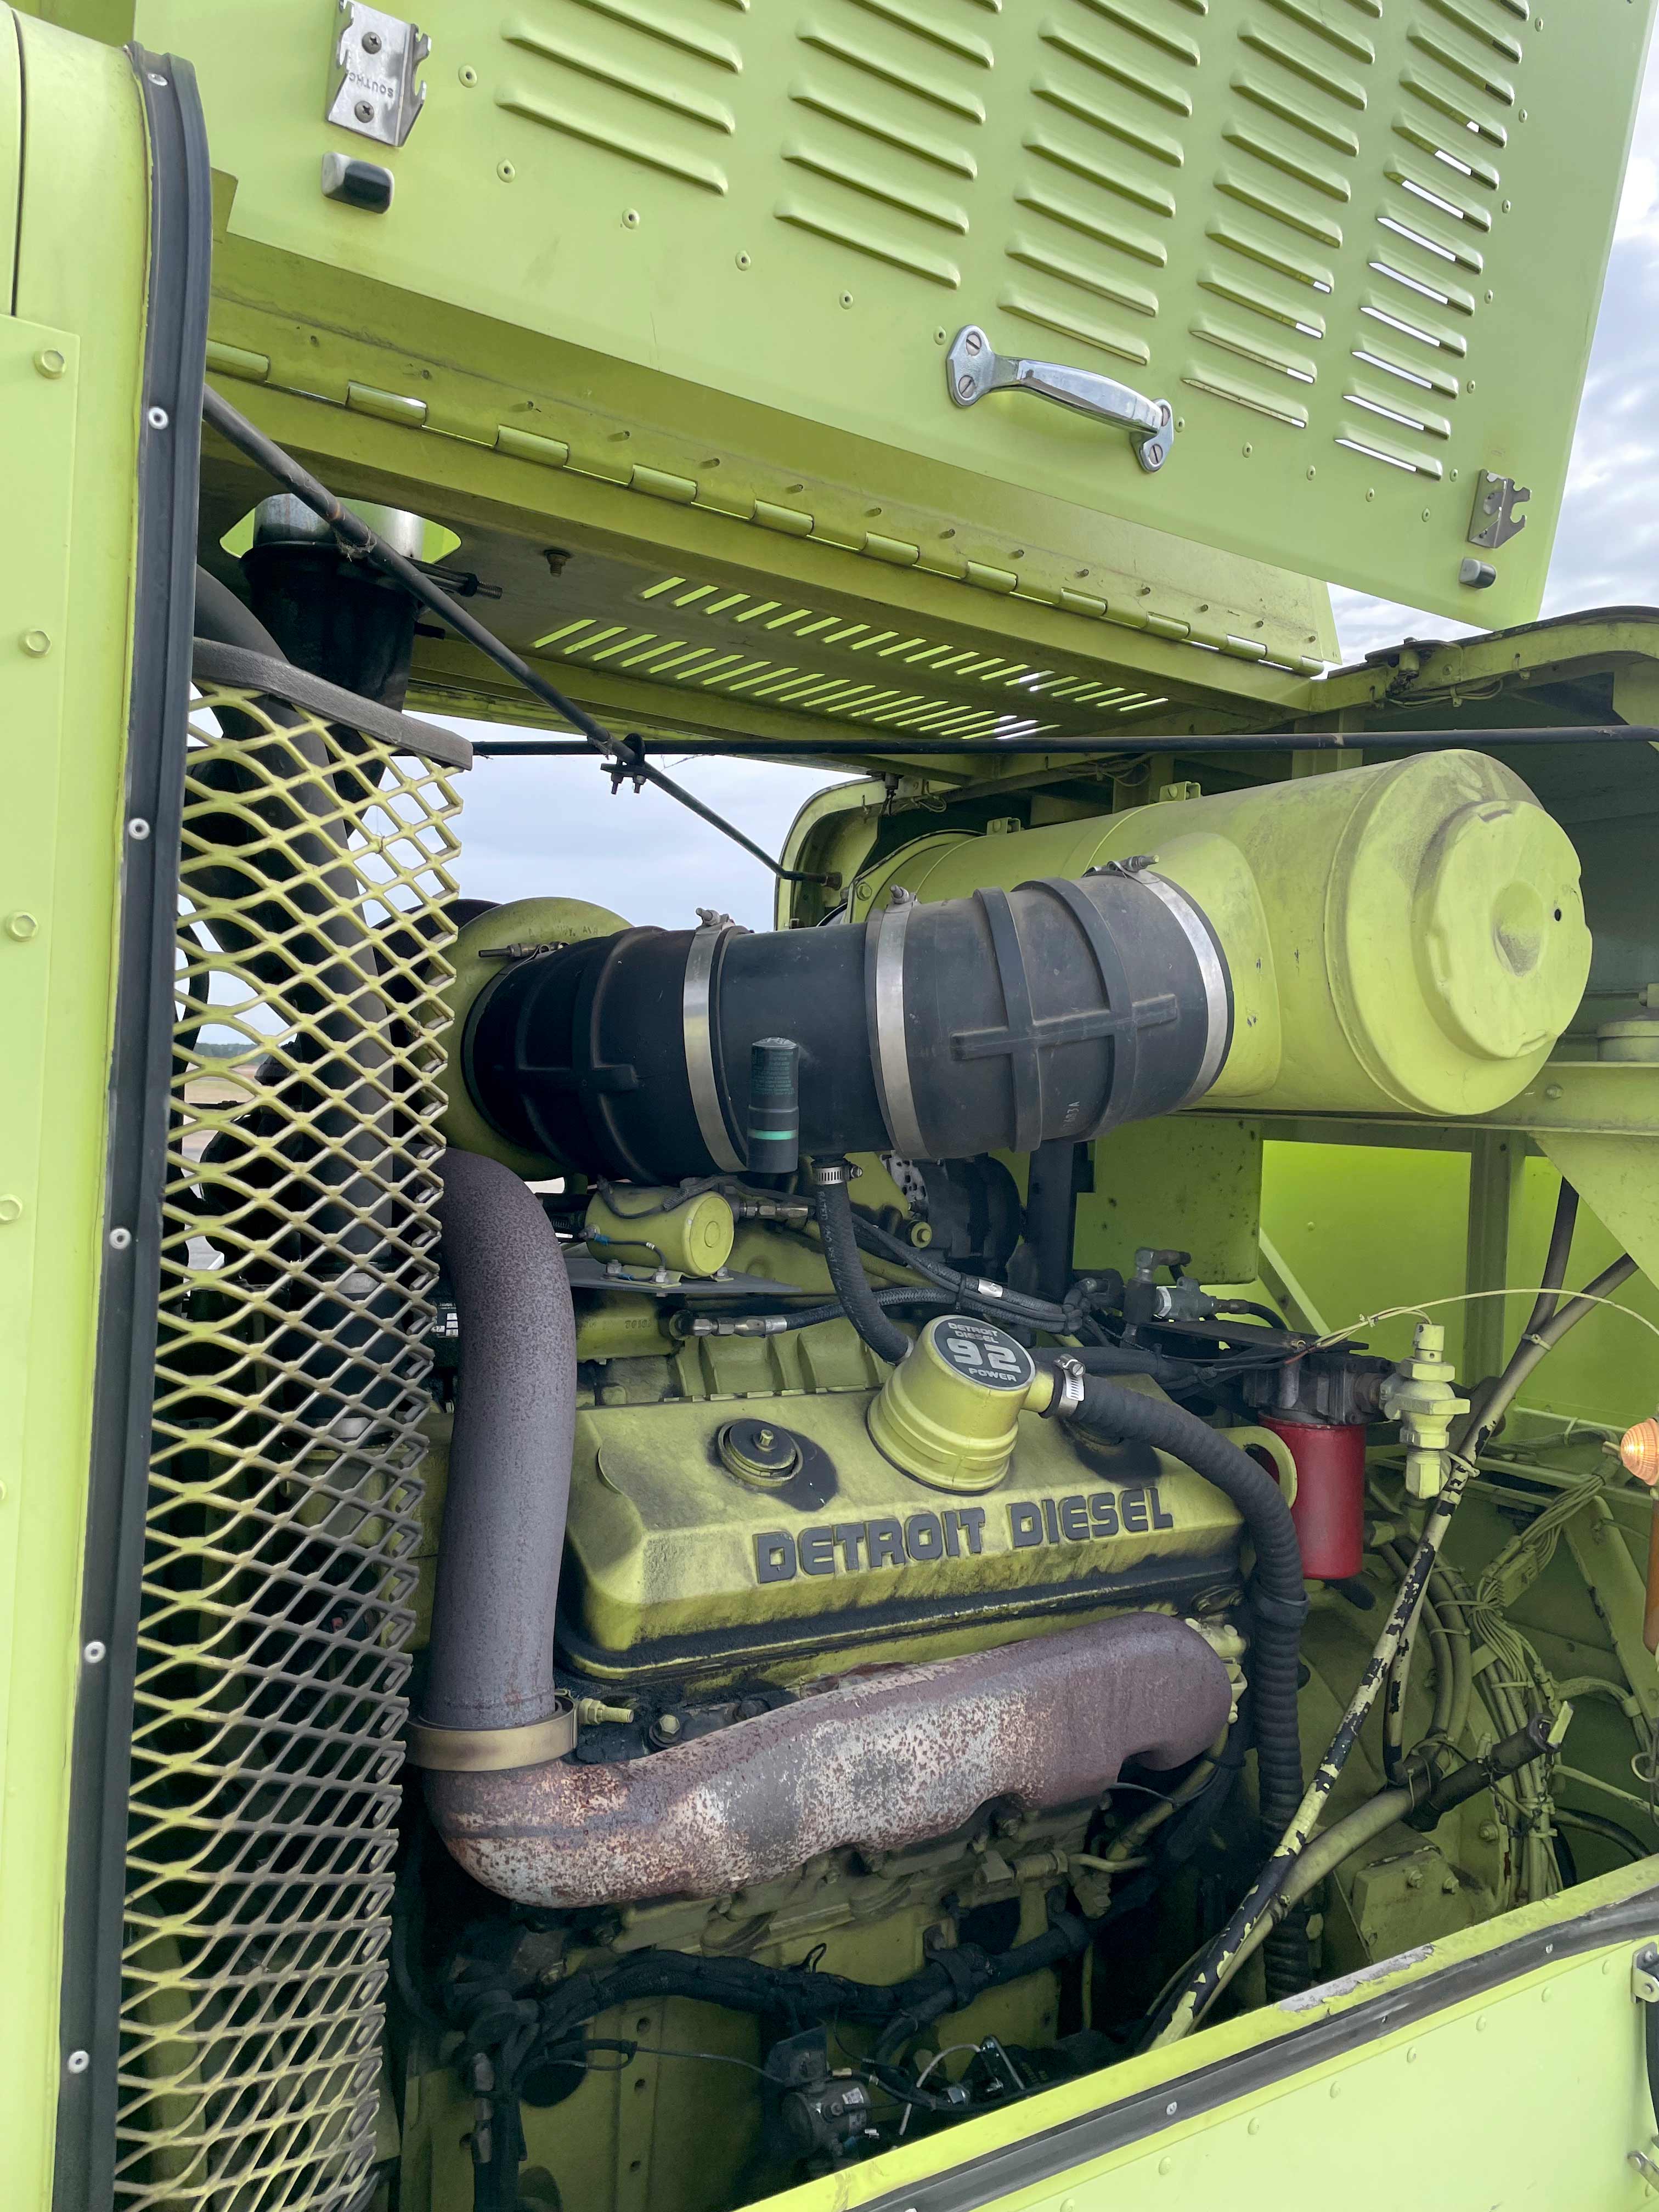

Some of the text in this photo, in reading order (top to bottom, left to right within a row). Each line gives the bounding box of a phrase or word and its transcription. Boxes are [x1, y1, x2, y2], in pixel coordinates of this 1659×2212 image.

[348, 72, 393, 98] SOUTHC
[947, 1322, 998, 1337] DETROIT
[955, 1330, 999, 1344] DIESEL
[946, 1338, 1022, 1373] 92
[968, 1367, 1017, 1382] POWER
[753, 1487, 1173, 1584] DETROIT DIESEL
